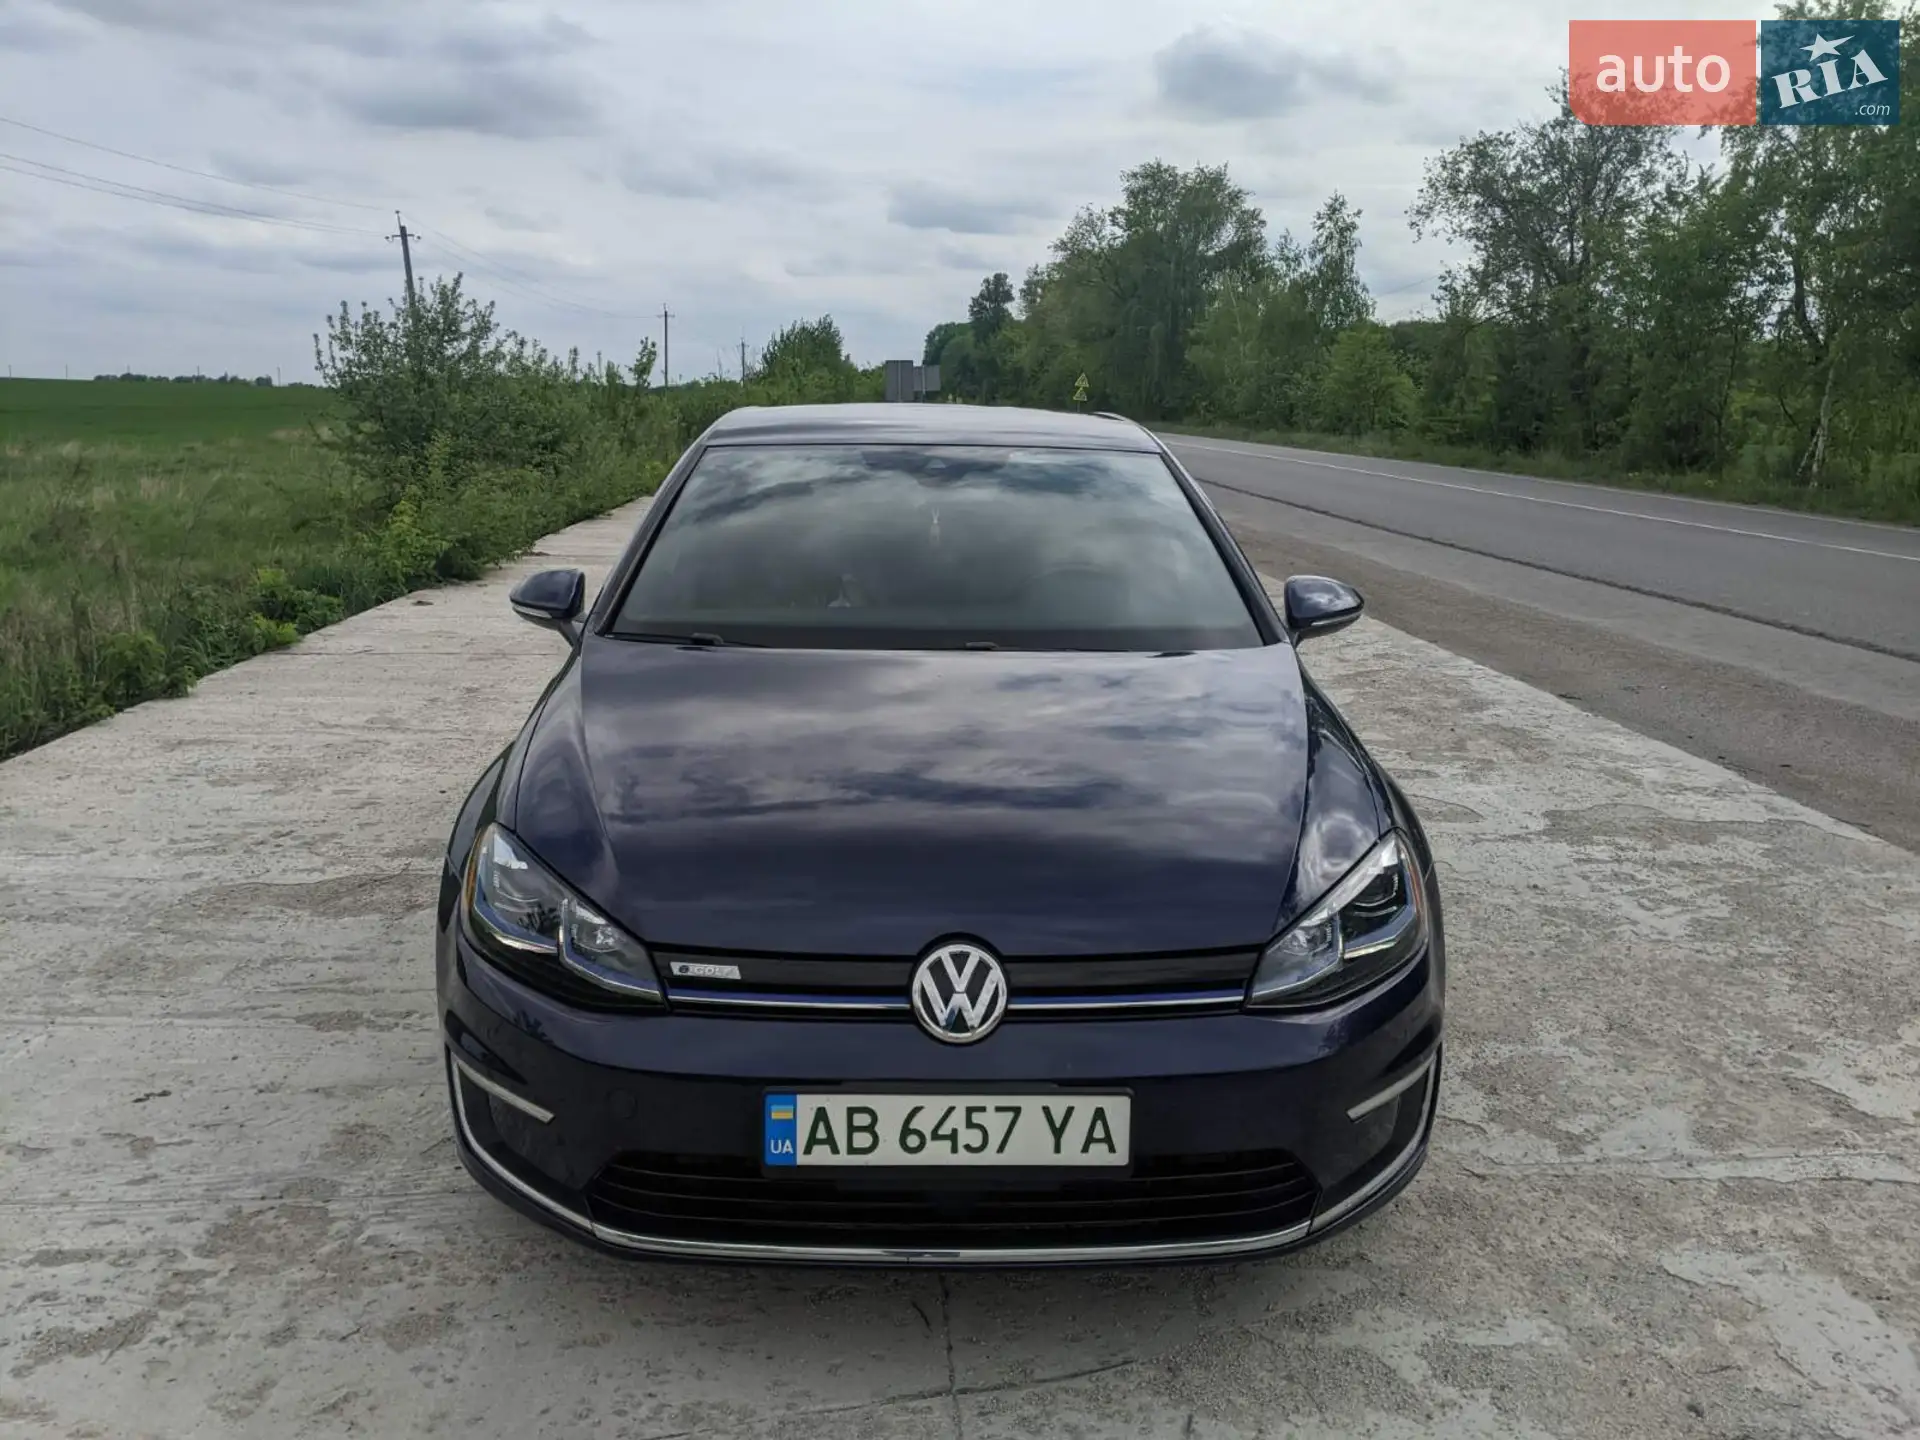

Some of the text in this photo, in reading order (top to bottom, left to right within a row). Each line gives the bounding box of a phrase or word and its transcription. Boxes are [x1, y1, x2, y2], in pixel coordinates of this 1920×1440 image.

[914, 946, 1005, 1041] VW
[770, 1139, 793, 1155] UA
[803, 1106, 1117, 1156] AB 6457 YA
